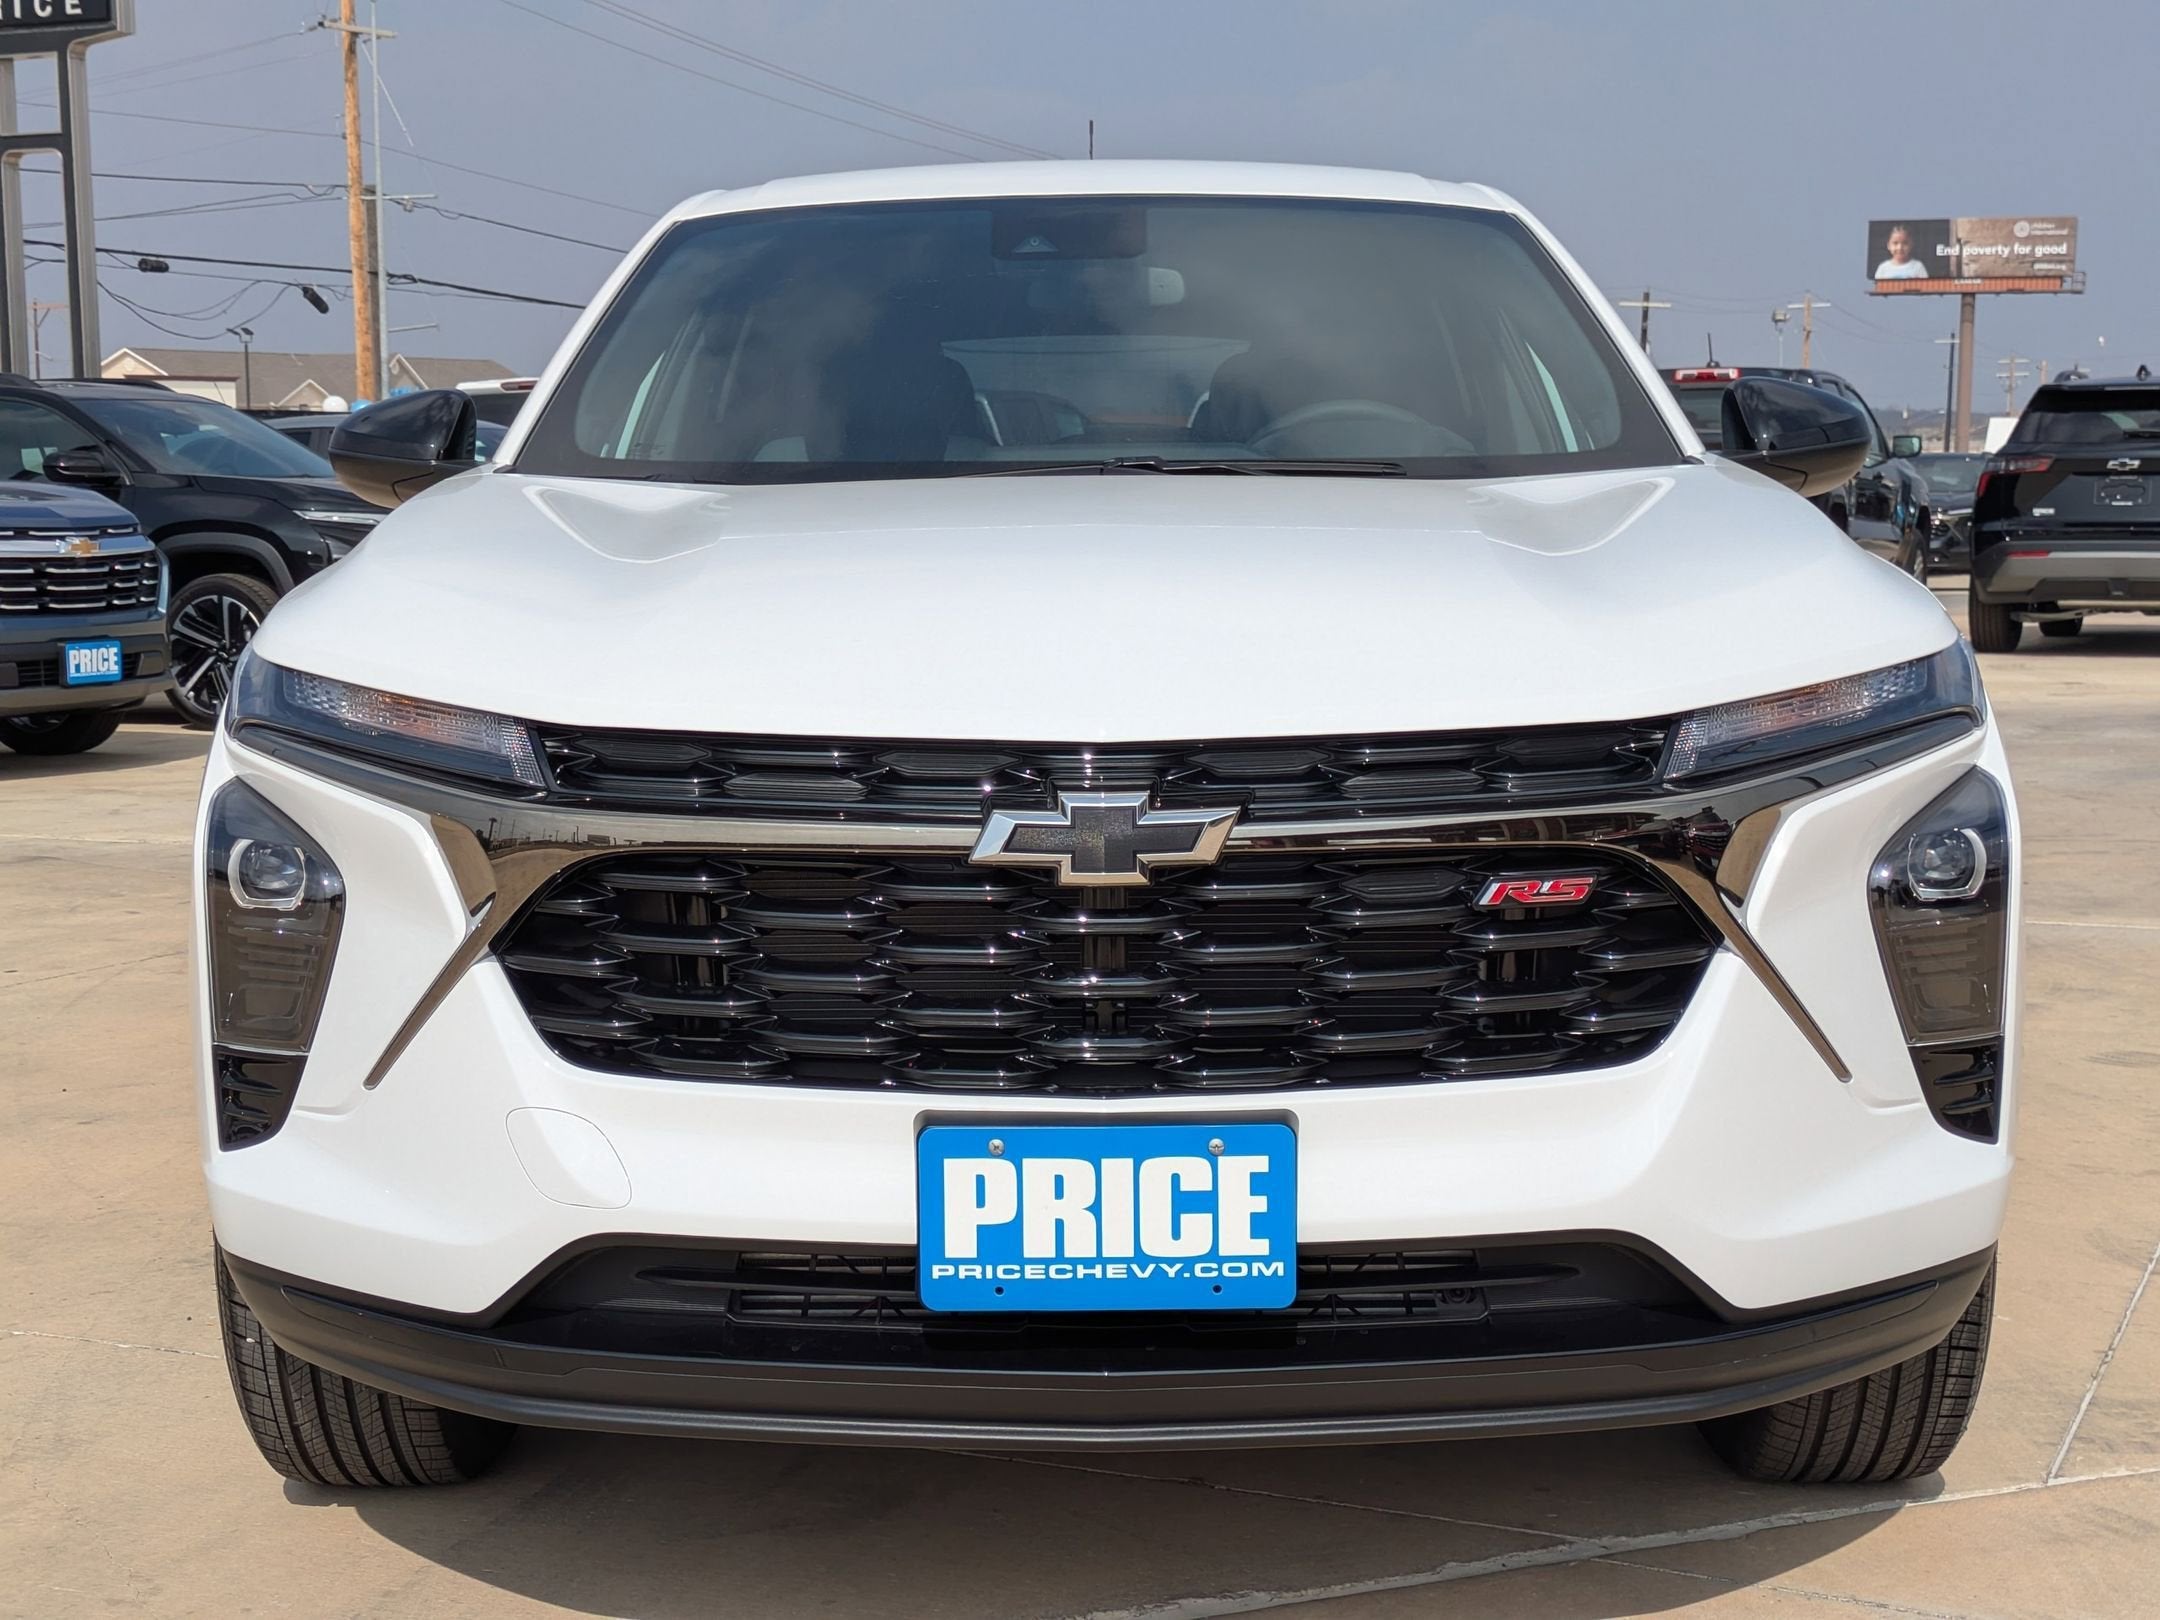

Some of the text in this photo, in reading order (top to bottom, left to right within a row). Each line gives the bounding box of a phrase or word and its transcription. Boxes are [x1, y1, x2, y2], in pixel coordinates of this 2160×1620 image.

[0, 0, 83, 20] ICE
[1936, 241, 2067, 258] End poverty for good
[68, 647, 119, 673] PRICE
[1479, 877, 1594, 905] RS
[943, 1155, 1270, 1259] PRICE
[931, 1261, 1285, 1280] PRICECHEVY.COM
